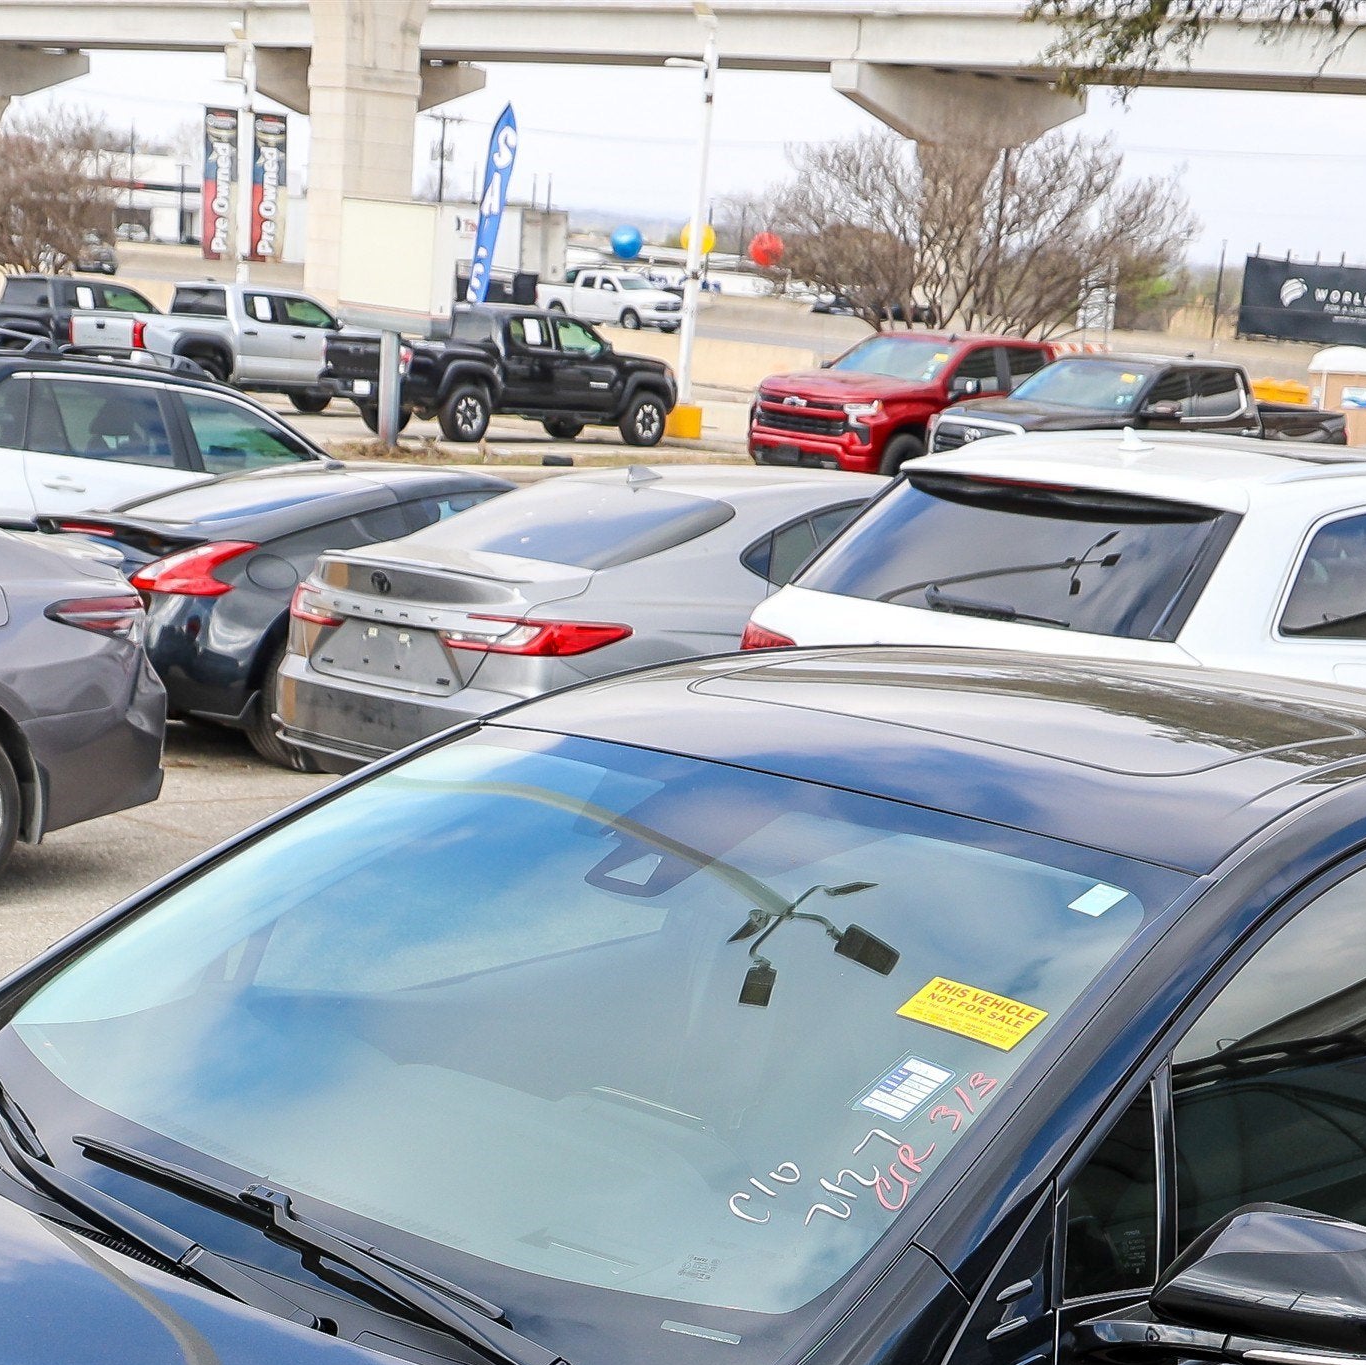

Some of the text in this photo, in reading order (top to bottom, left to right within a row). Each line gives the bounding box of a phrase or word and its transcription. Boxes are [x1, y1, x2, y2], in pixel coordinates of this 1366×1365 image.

[212, 141, 232, 216] Owned
[259, 147, 280, 219] Owned
[211, 216, 229, 253] Pre
[256, 220, 276, 255] Pre
[927, 992, 956, 1006] NOT
[956, 1001, 986, 1016] FOR
[987, 1011, 1026, 1029] SALE
[933, 981, 1039, 1022] THIS VEHICLE
